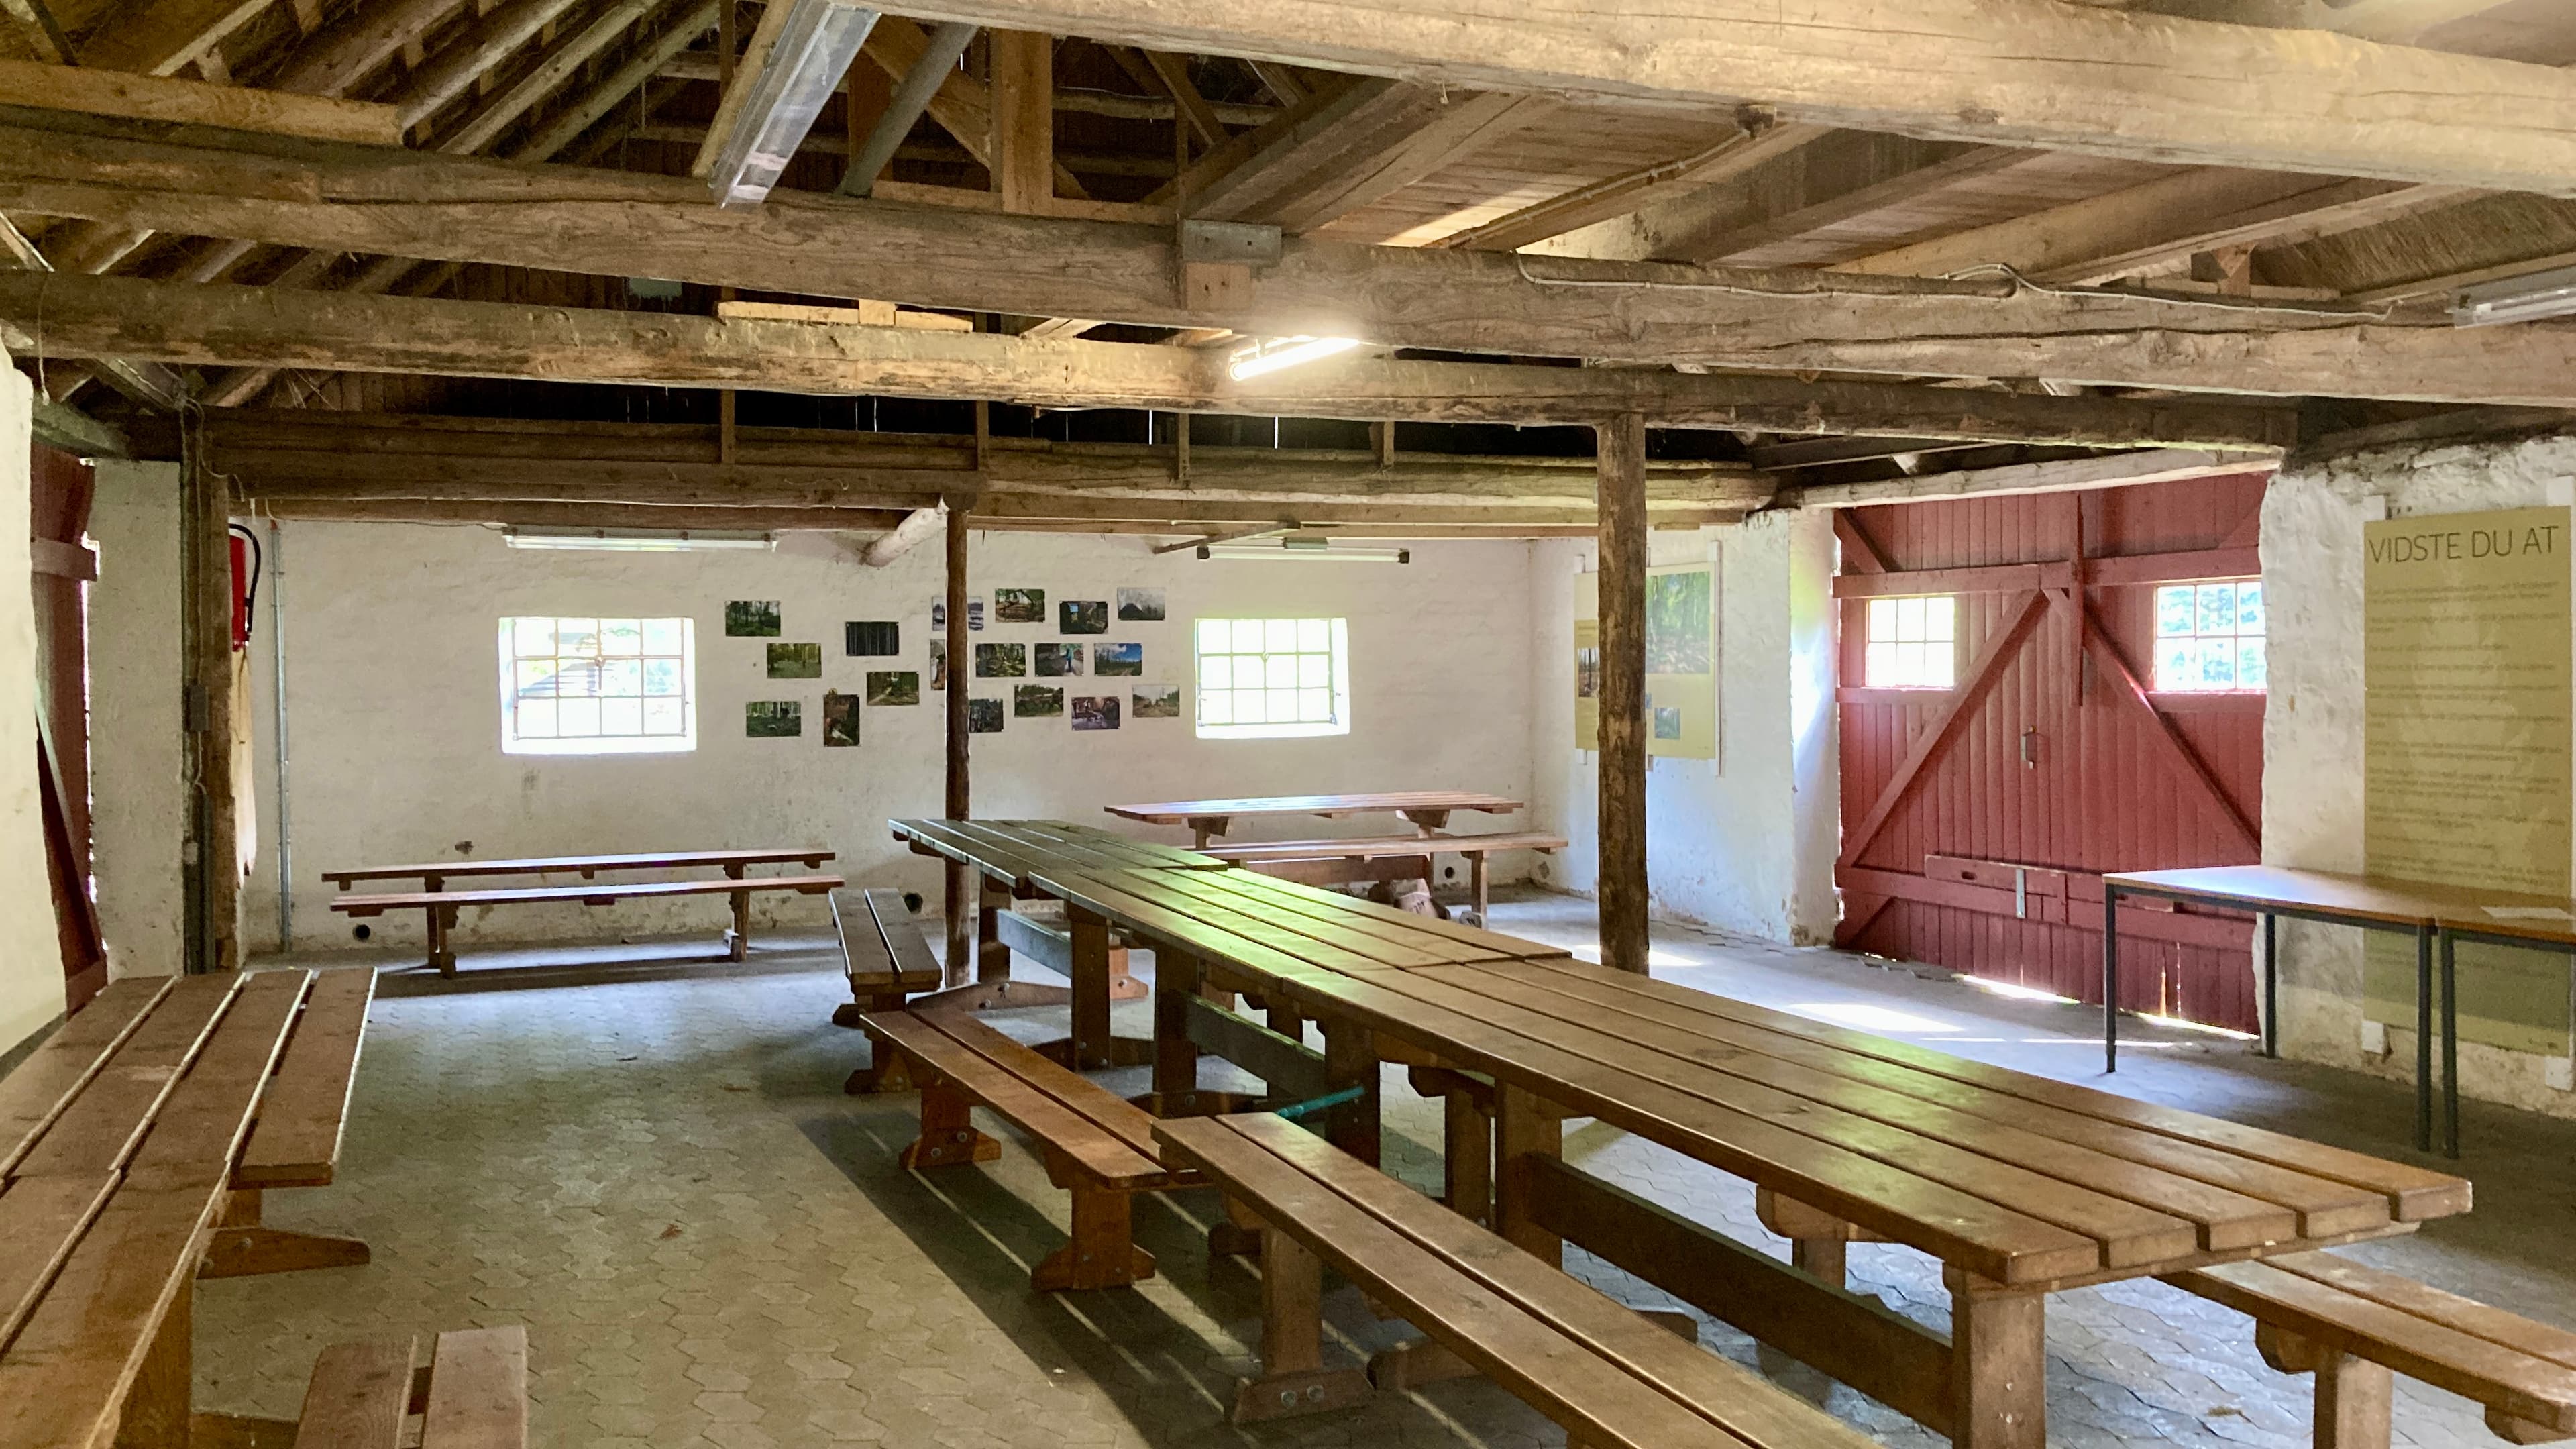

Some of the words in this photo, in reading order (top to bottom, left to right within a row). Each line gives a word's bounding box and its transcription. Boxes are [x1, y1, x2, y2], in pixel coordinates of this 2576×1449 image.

[2369, 533, 2462, 563] VIDSTE
[2471, 529, 2513, 558] DU
[2522, 525, 2559, 555] AT
